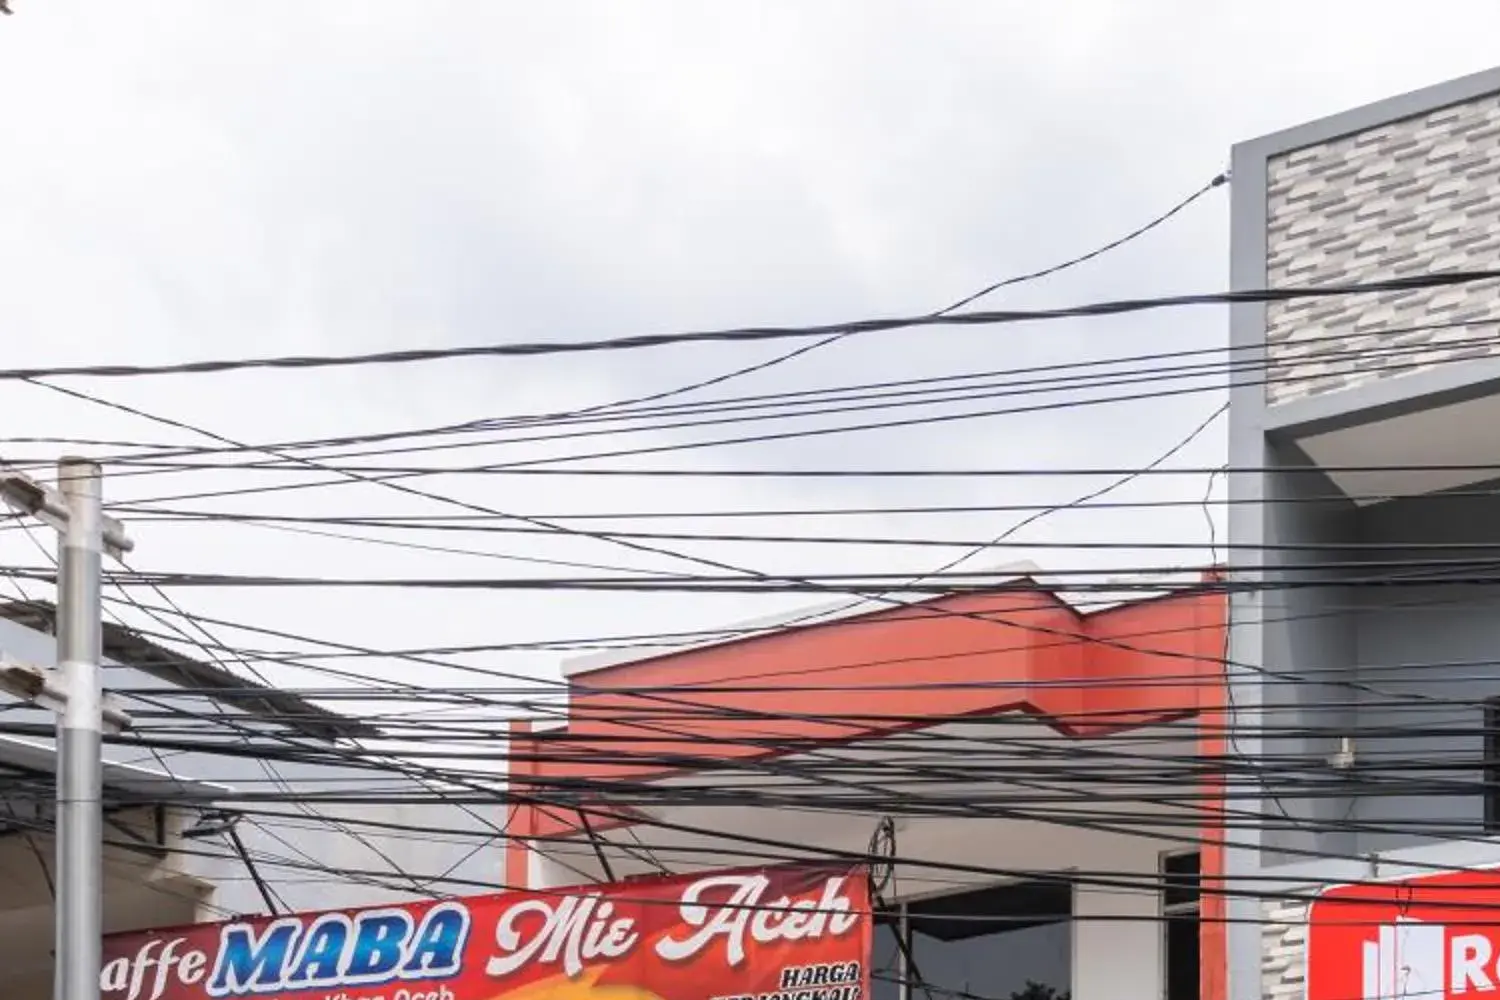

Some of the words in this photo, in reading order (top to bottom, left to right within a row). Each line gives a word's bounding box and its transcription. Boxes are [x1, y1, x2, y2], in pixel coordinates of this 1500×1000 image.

[206, 902, 471, 997] MABA
[486, 893, 640, 978] Mie
[656, 875, 859, 967] Aceh
[782, 962, 860, 990] HARGA
